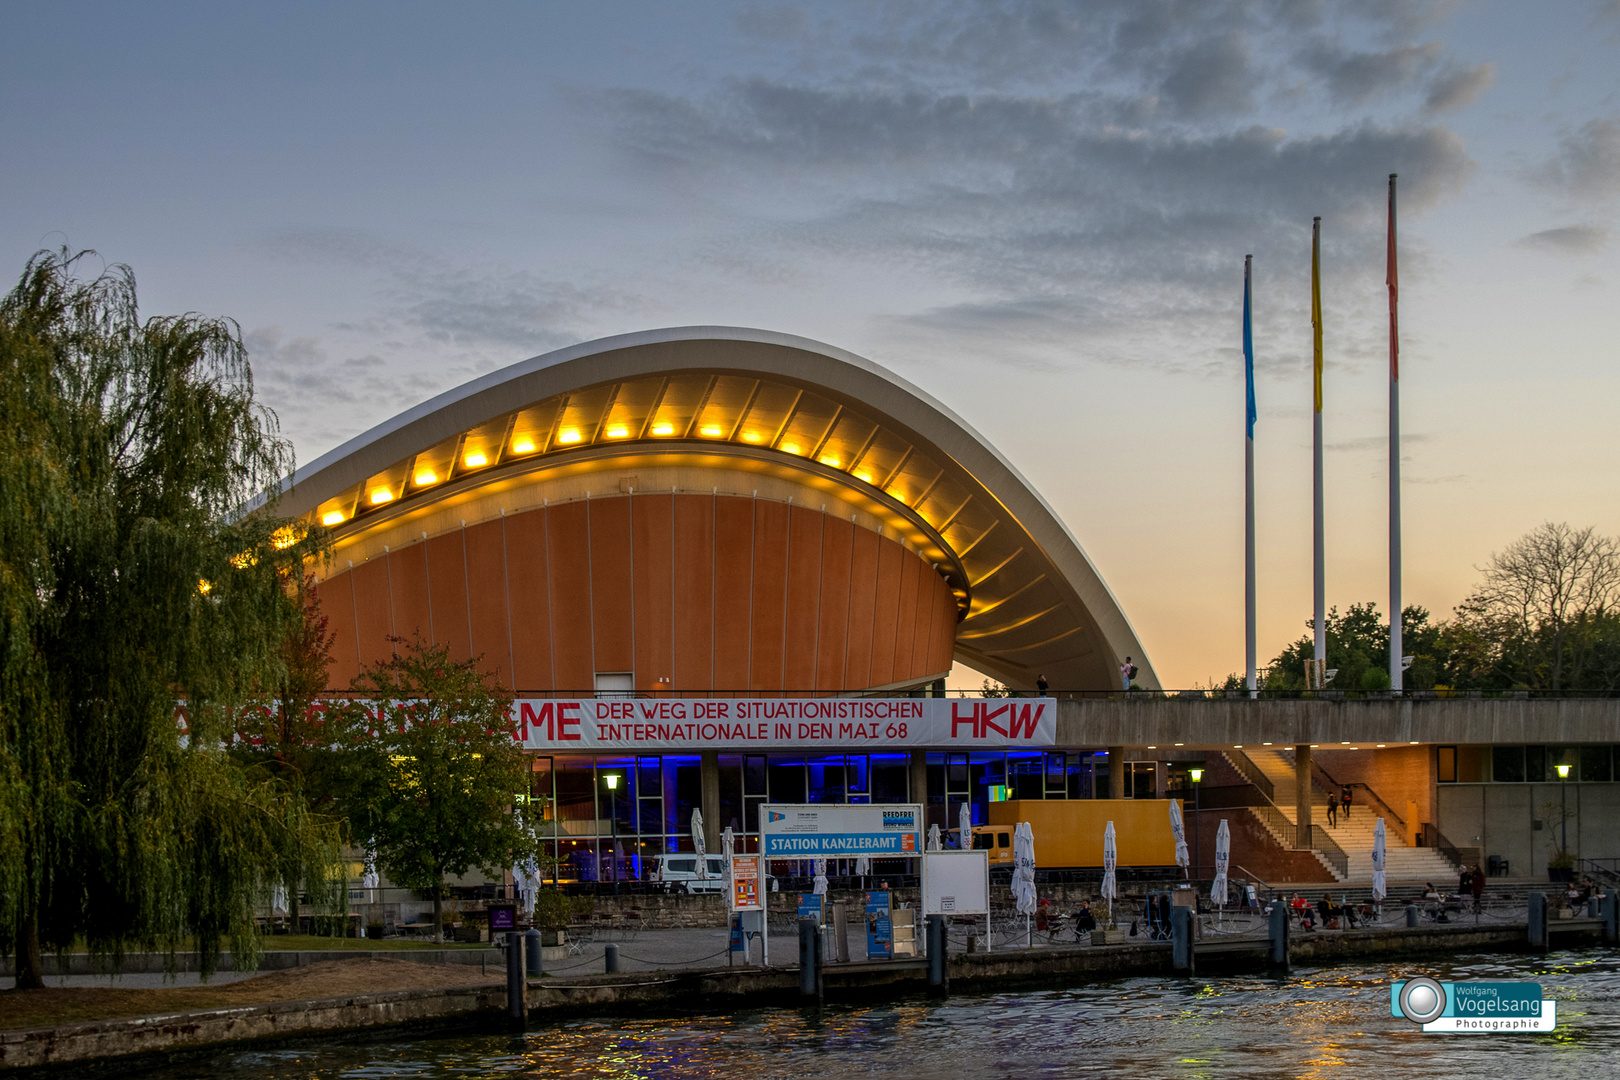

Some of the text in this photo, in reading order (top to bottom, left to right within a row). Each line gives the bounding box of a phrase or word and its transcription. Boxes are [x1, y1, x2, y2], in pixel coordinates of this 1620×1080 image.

[597, 702, 923, 719] DER WEG DER SITUATIONISTISCHEN
[456, 702, 581, 742] AME
[951, 702, 1046, 739] HKW
[597, 723, 908, 741] INTERNATIONALE IN DEN MAI 68
[770, 838, 819, 851] STATION
[821, 837, 897, 850] KANZLERAMT
